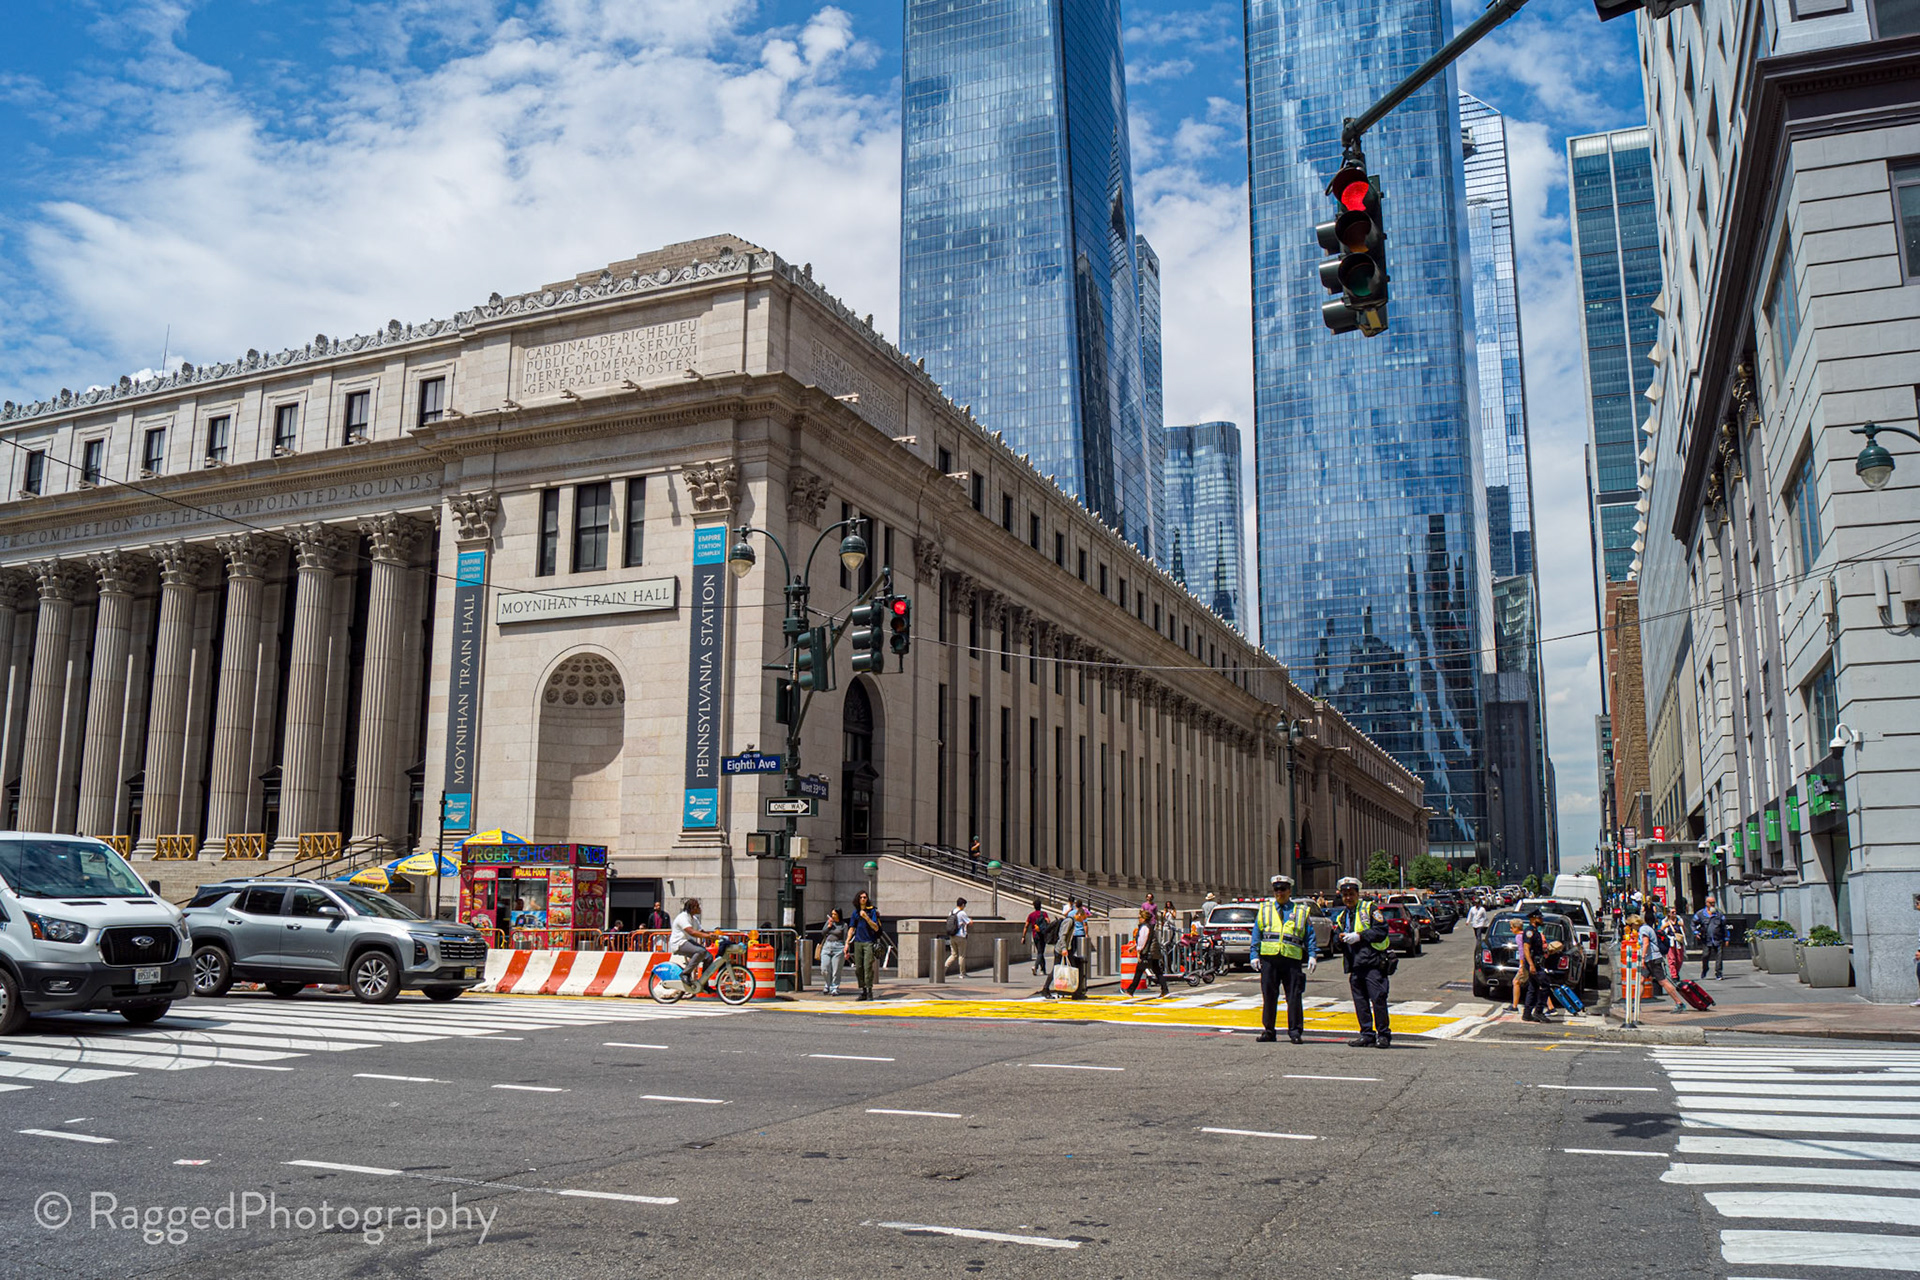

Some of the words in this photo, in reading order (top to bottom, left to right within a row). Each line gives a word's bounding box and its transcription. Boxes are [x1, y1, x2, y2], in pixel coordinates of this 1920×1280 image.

[526, 339, 593, 360] CARDINAL
[600, 334, 616, 348] DE
[622, 320, 697, 343] RICHELIEU
[526, 354, 575, 372] PUBLIC
[583, 346, 633, 363] POSTAL
[639, 333, 697, 353] SERVICE
[526, 367, 569, 384] PIERRE
[575, 356, 644, 376] D'ALMERAS
[648, 345, 697, 363] MDCXXI
[528, 377, 595, 395] GENERAL
[603, 370, 630, 383] DES
[638, 358, 691, 376] POSTES
[27, 516, 134, 545] COMPLETION
[142, 514, 161, 528] OF
[171, 504, 224, 524] THEIR
[232, 487, 338, 516] APPOINTED
[349, 473, 434, 498] ROUNDS
[698, 534, 721, 542] EMPIRE
[698, 550, 721, 558] COMPLEX
[462, 594, 475, 634] HALL
[501, 598, 578, 614] MOYNIHAN
[584, 592, 627, 607] TRAIN
[633, 588, 669, 602] HALL
[701, 574, 715, 646] STATION
[459, 639, 472, 689] TRAIN
[696, 652, 713, 778] PENNSYLVANIA
[454, 694, 469, 784] MOYNIHAN
[727, 759, 756, 772] Eighth
[758, 760, 776, 769] Ave
[801, 782, 812, 793] West
[821, 786, 827, 796] St
[515, 868, 531, 877] HALAL
[532, 868, 547, 877] FOOD
